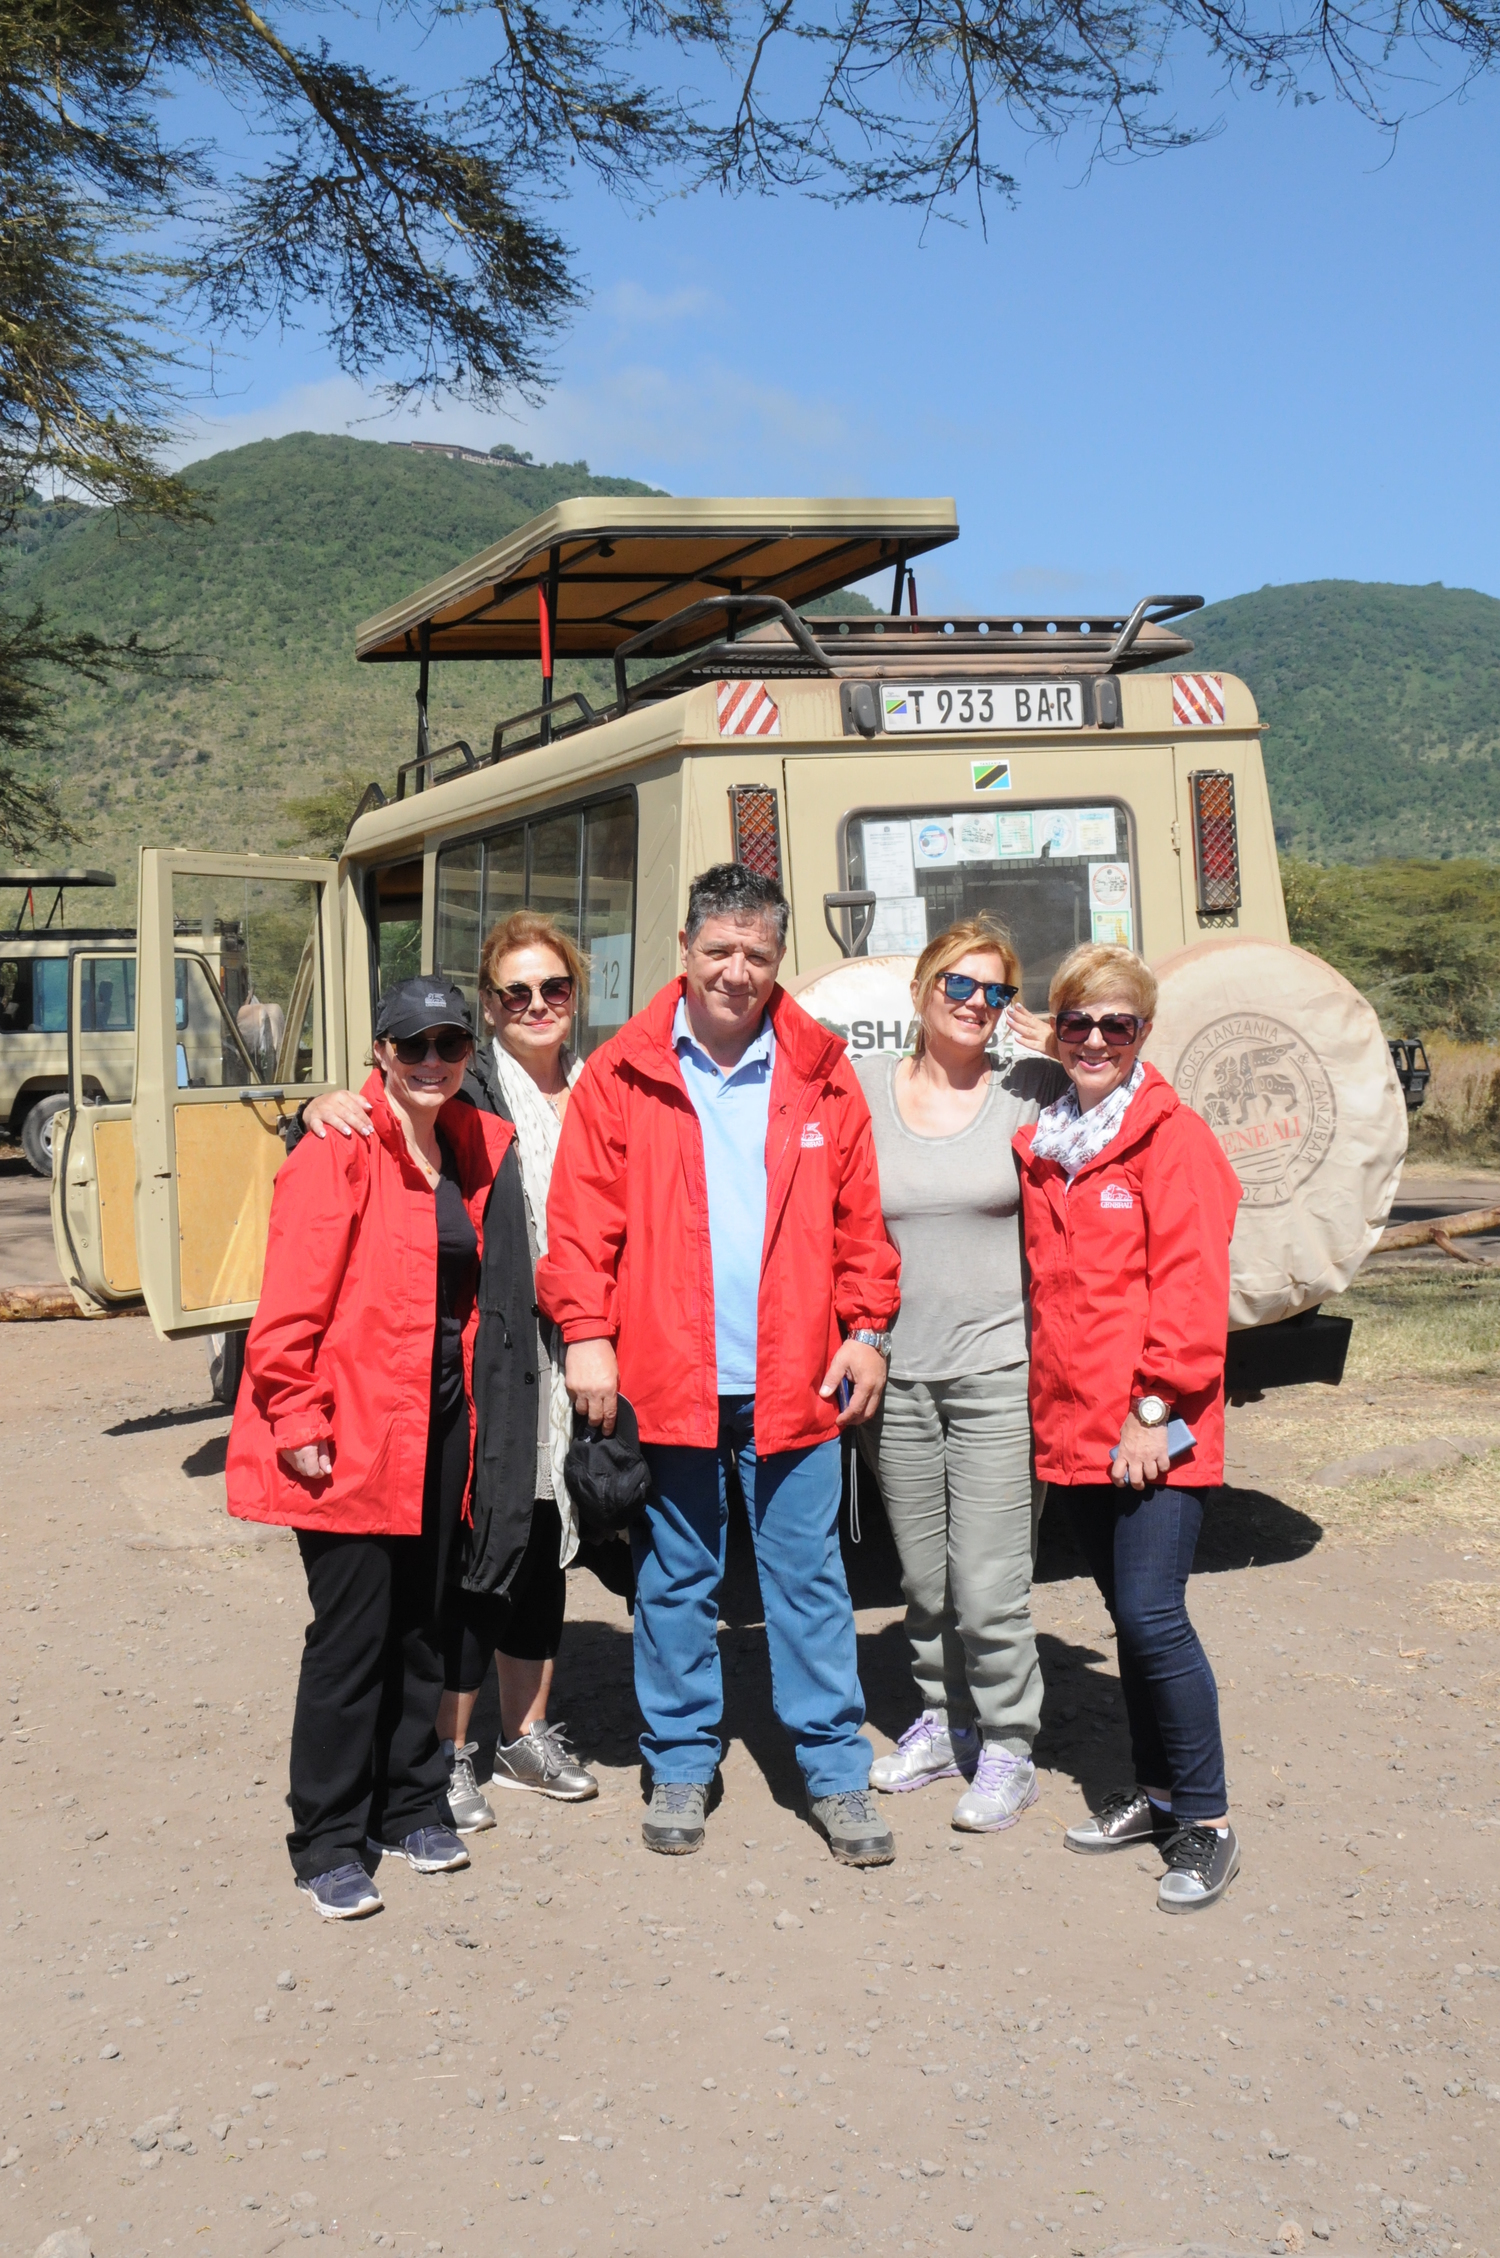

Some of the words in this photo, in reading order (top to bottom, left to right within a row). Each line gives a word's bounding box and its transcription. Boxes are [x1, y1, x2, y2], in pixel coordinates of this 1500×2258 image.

[907, 690, 925, 725] T
[936, 688, 994, 724] 933
[1014, 687, 1074, 723] BAR
[602, 960, 620, 1000] 12
[851, 1020, 924, 1050] SHA
[1178, 1045, 1205, 1090] GOES
[1202, 1020, 1279, 1048] TANZANIA
[1300, 1077, 1331, 1165] ZANZIBAR
[1217, 1115, 1304, 1156] ENEALI
